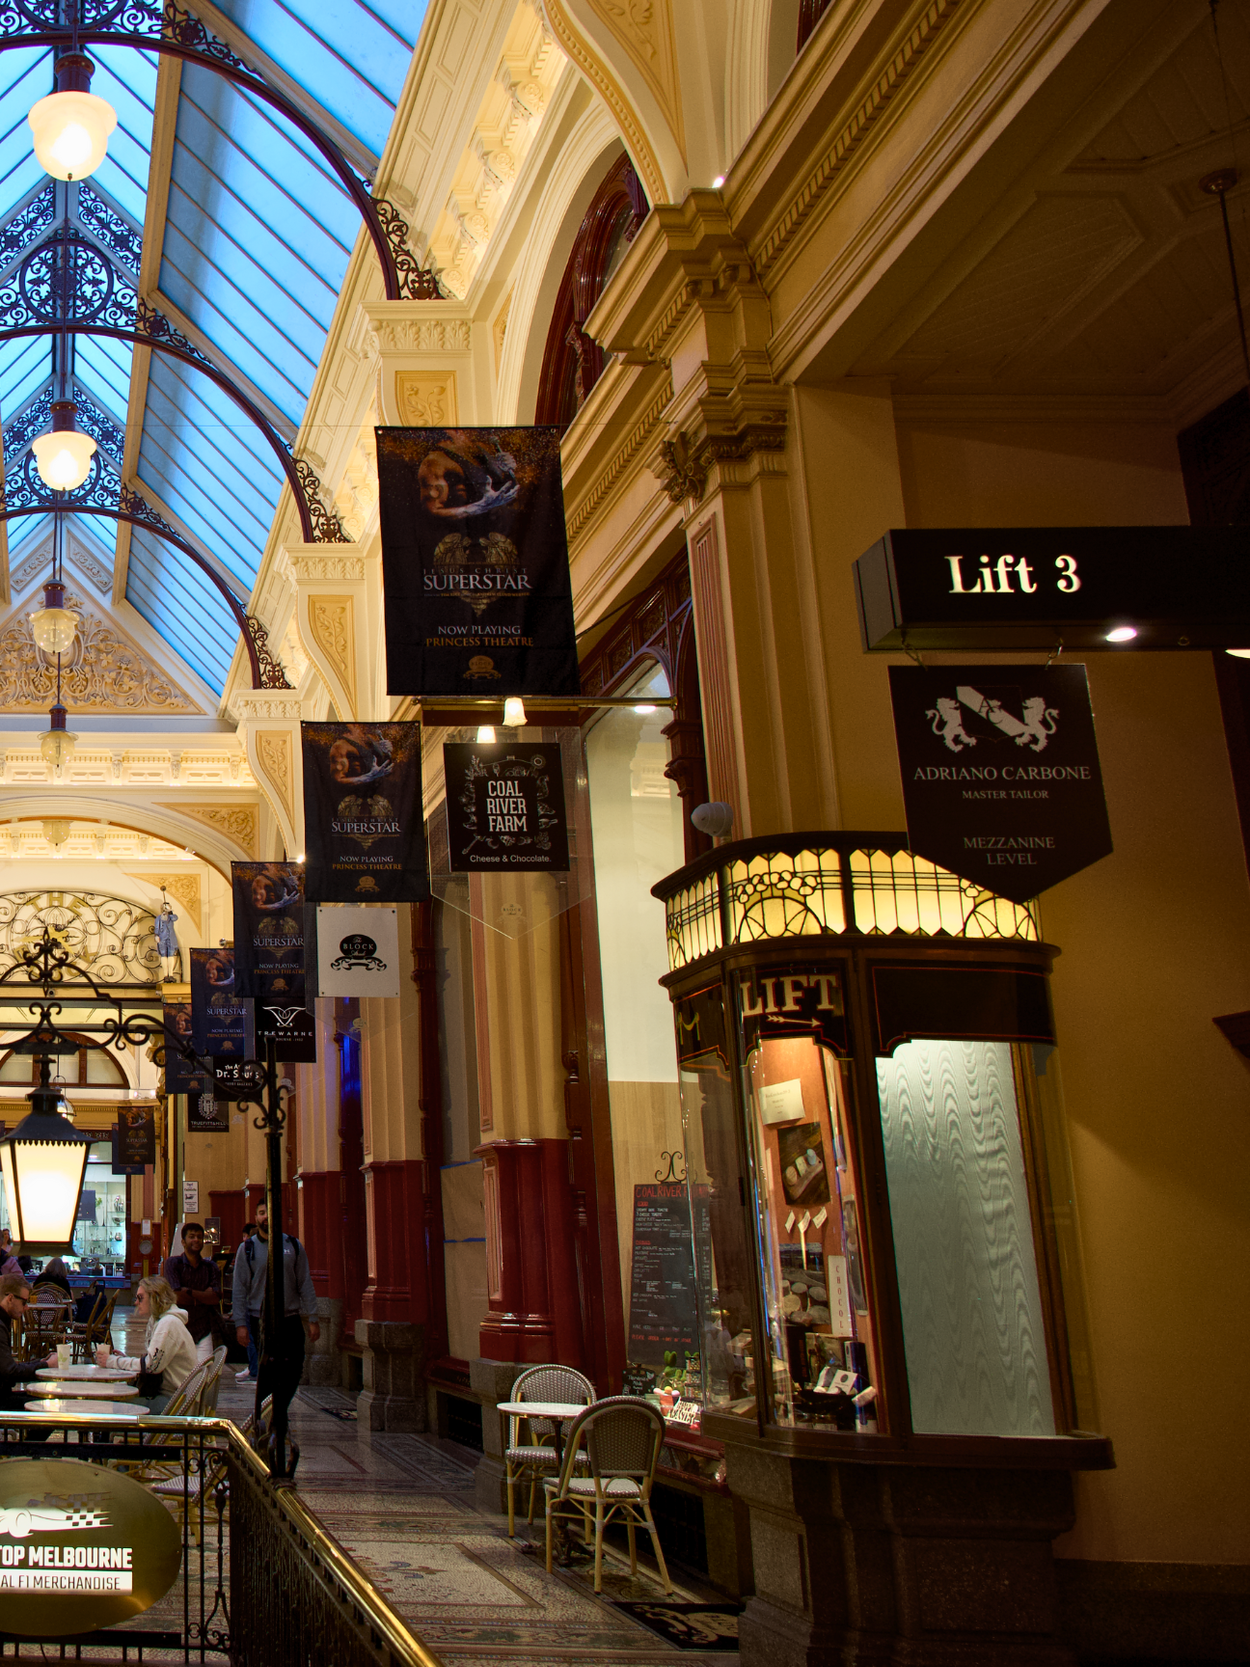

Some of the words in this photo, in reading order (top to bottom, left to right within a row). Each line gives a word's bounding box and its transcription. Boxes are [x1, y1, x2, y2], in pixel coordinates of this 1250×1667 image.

[423, 567, 465, 575] JESUS
[475, 567, 528, 575] CHRIST
[945, 555, 1037, 594] Lift
[1055, 555, 1082, 594] 3
[423, 574, 533, 591] SUPERSTAR
[438, 626, 468, 635] NOW
[471, 625, 521, 635] PLAYING
[426, 637, 480, 647] PRINCESS
[482, 637, 534, 647] THEATRE
[914, 765, 998, 781] ADRIANO
[1002, 764, 1091, 781] CARBONE
[487, 780, 523, 797] COAL
[962, 789, 1006, 799] MASTER
[1009, 789, 1049, 799] TAILOR
[486, 797, 527, 814] RIVER
[331, 821, 402, 834] SUPERSTAR
[488, 815, 528, 832] FARM
[963, 836, 1055, 849] MEZZANINE
[361, 855, 394, 863] PLAYING
[469, 854, 501, 863] Cheese
[501, 855, 509, 863] &
[986, 852, 1037, 866] LEVEL
[253, 937, 305, 946] SUPERSTAR
[740, 974, 837, 1017] LIFT
[215, 1069, 230, 1078] Dr.
[28, 1546, 133, 1569] MELBOURNE
[18, 1574, 30, 1588] F1
[33, 1575, 121, 1591] MERCHANDISE
